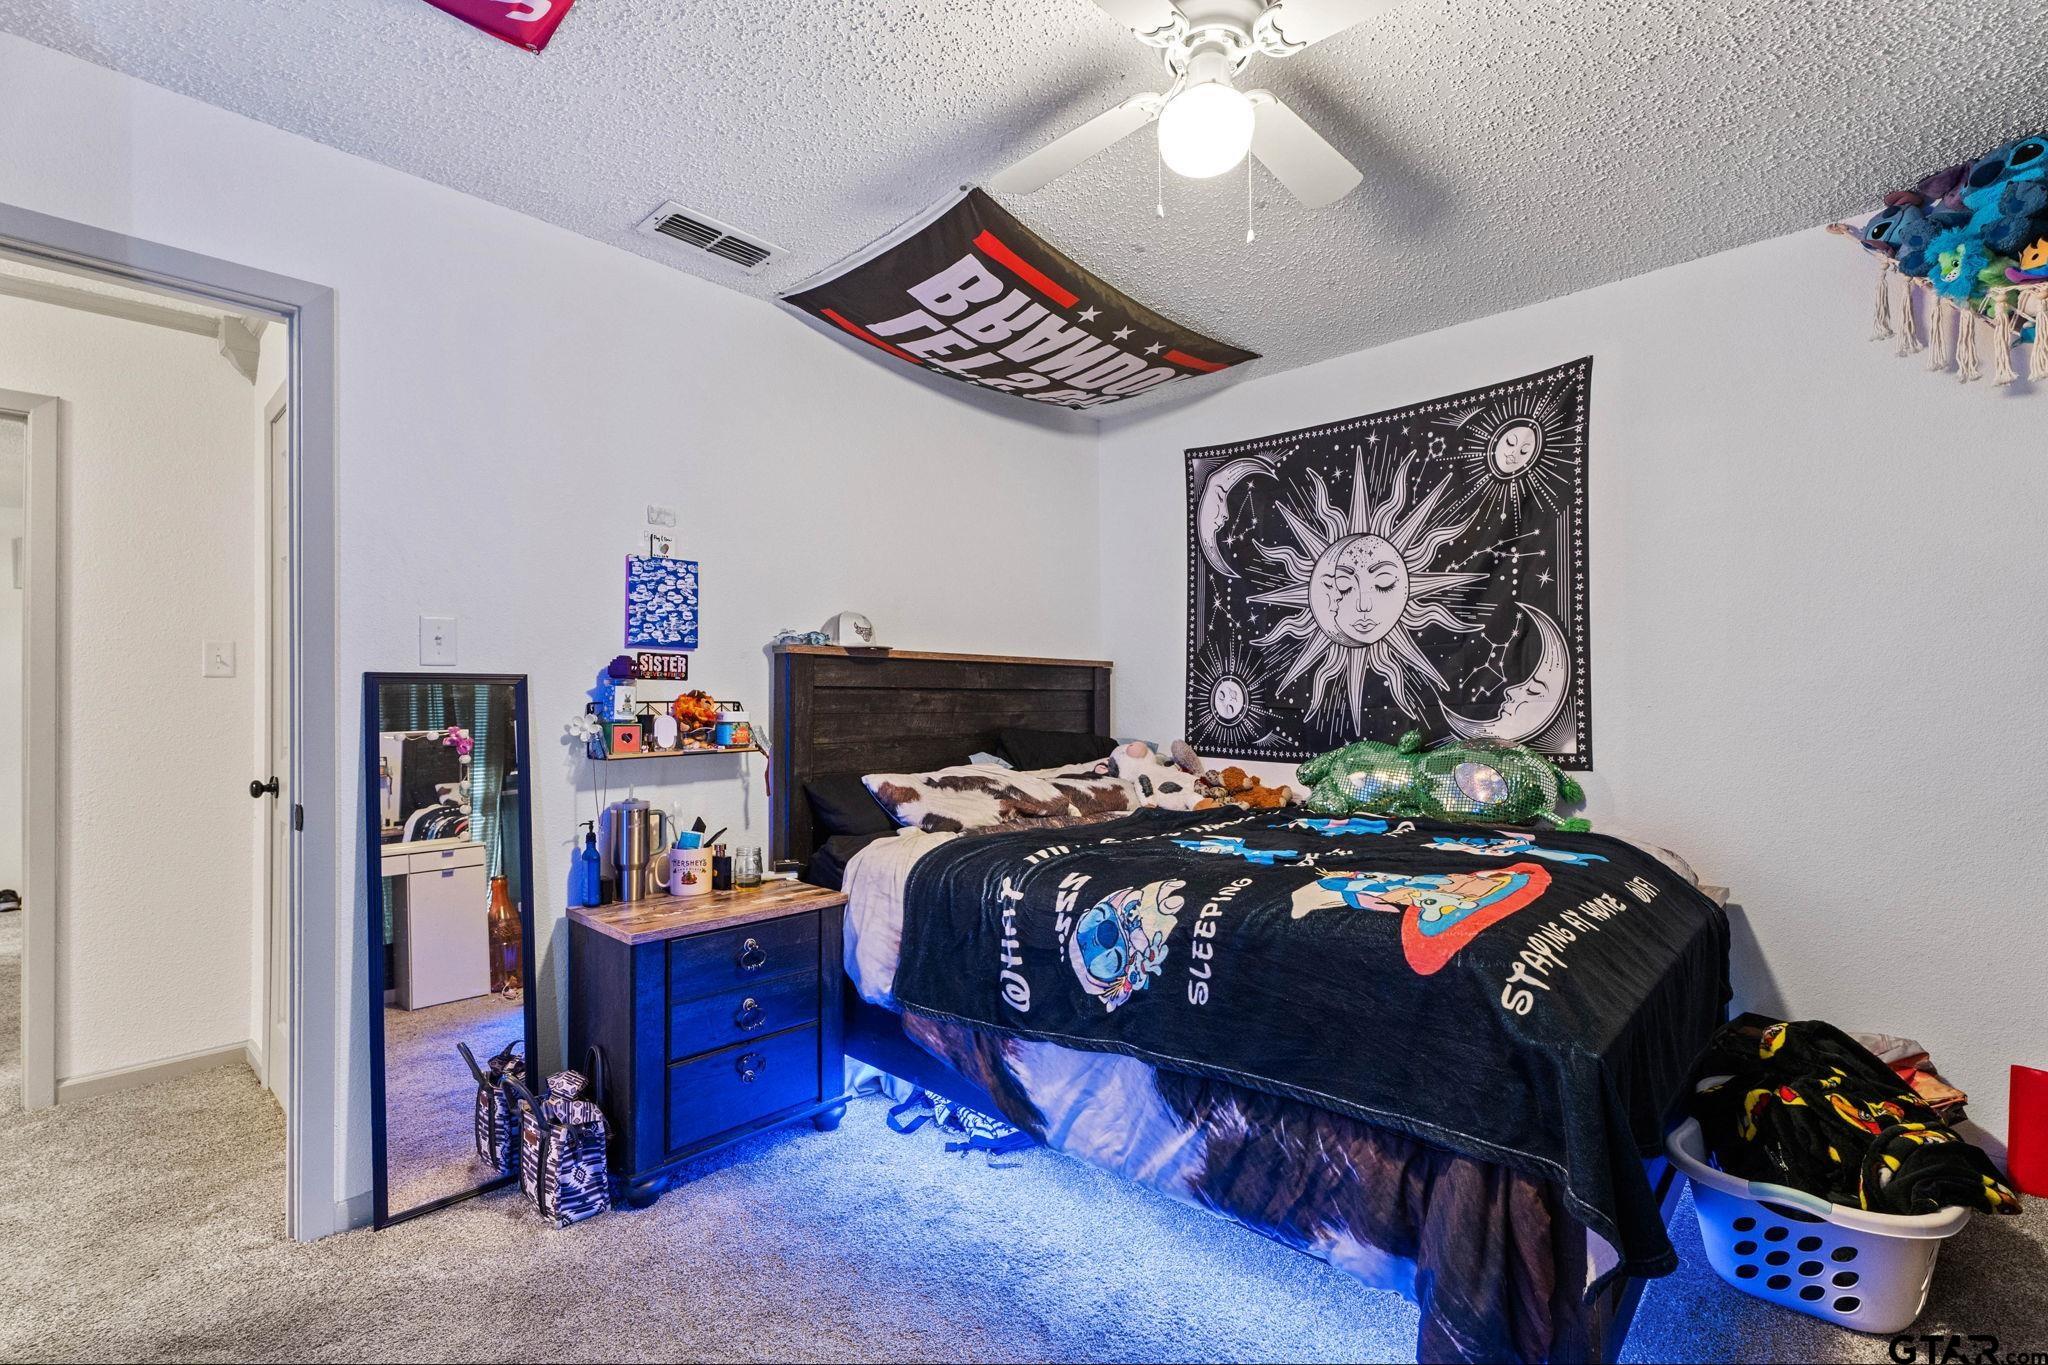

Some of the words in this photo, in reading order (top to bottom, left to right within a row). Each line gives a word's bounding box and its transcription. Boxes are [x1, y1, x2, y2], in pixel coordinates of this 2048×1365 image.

[639, 654, 686, 673] SISTER
[1188, 878, 1253, 1005] SLEEPING
[1501, 922, 1577, 1015] STAYING
[1578, 893, 1627, 921] HOME
